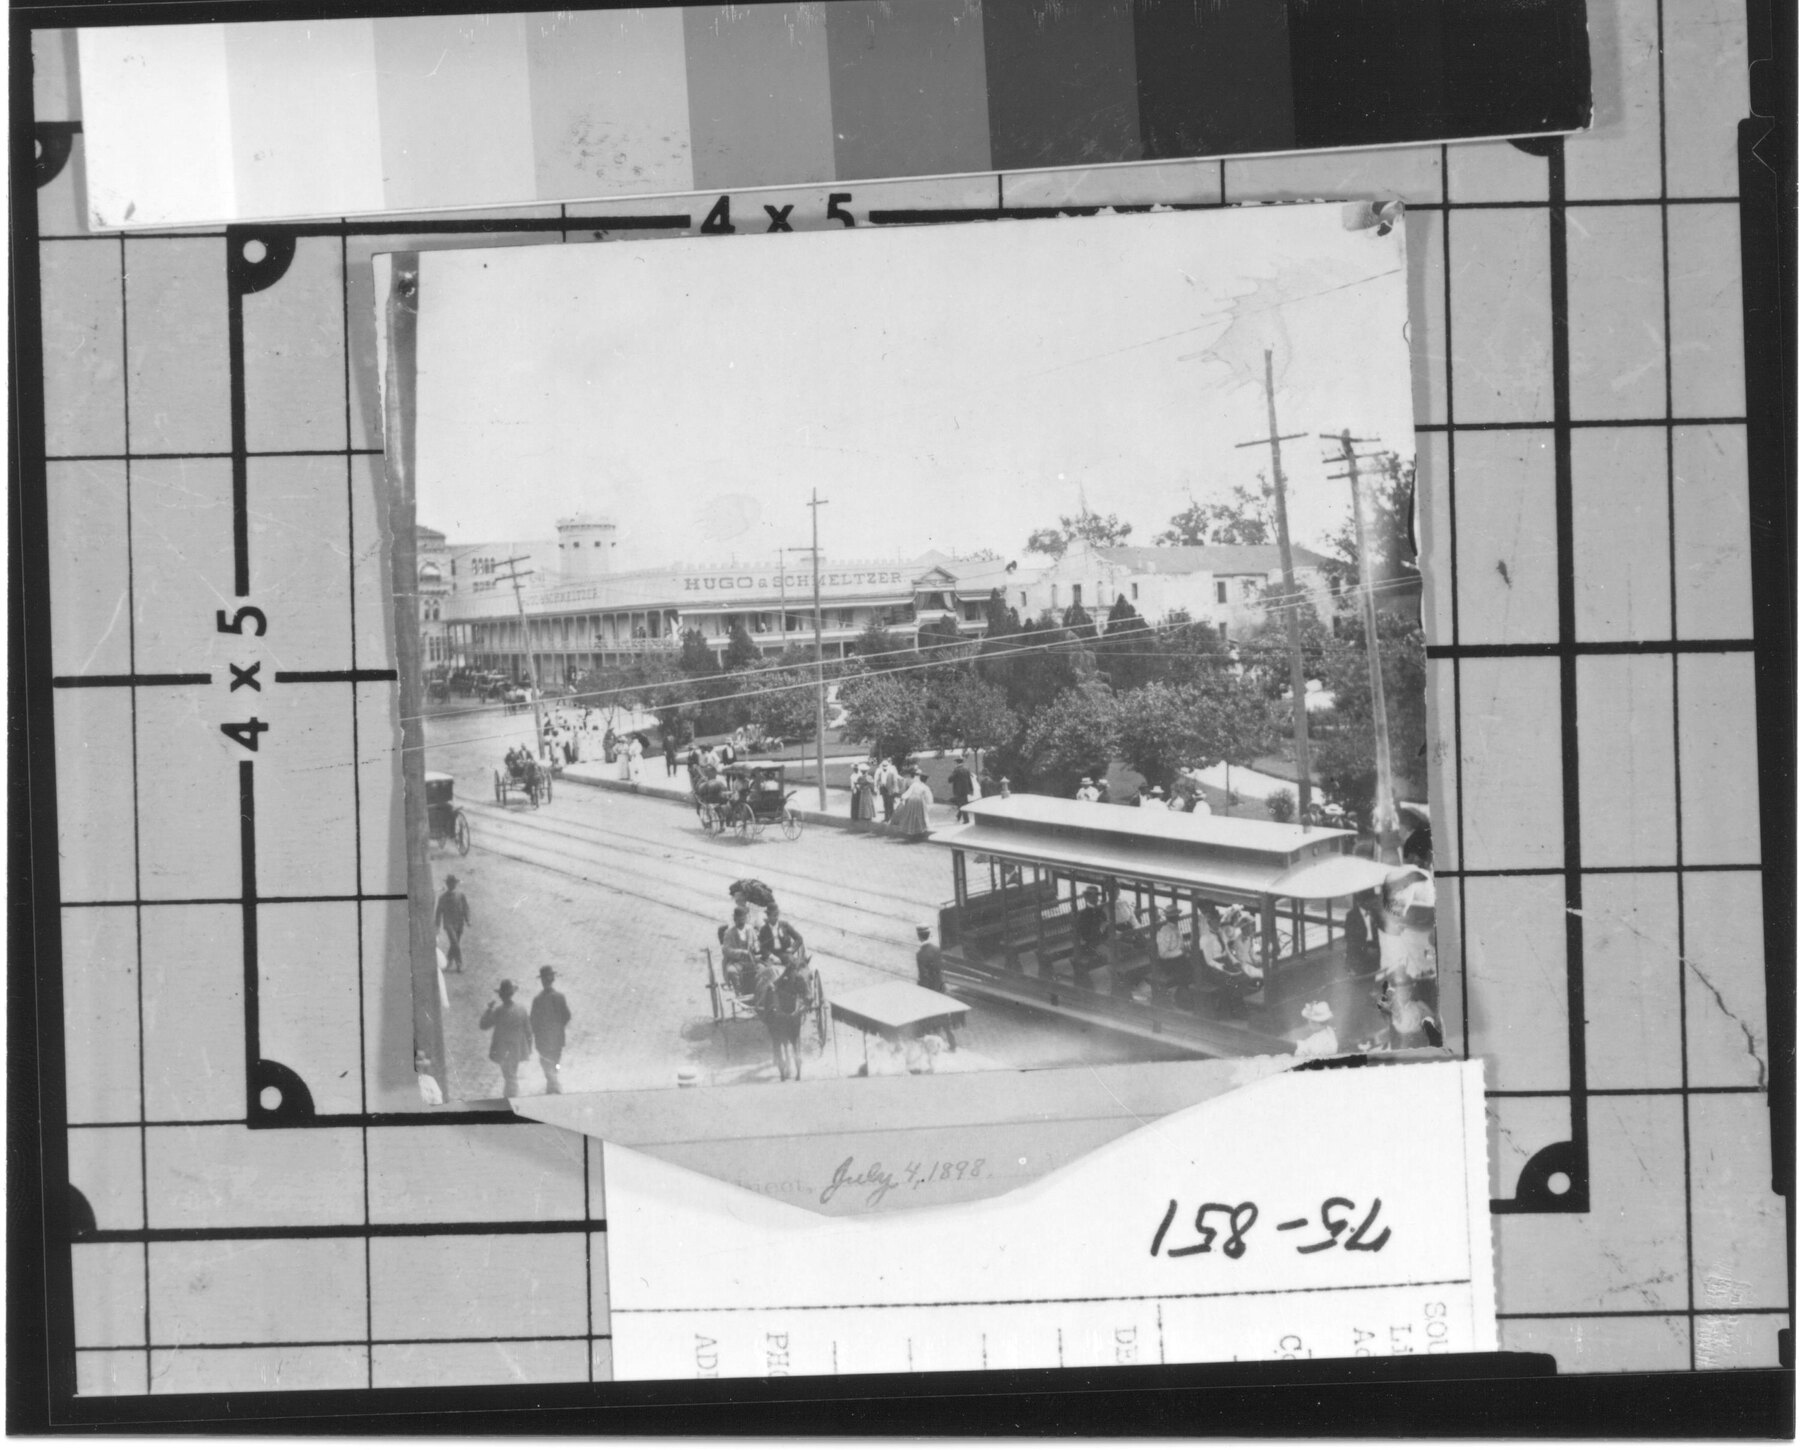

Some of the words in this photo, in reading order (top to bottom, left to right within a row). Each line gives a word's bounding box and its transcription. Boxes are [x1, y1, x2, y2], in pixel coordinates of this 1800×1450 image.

[701, 195, 736, 234] 4
[763, 204, 795, 233] x
[684, 576, 754, 591] HUGO
[758, 578, 769, 589] &
[772, 572, 903, 589] SCHMELTZER
[216, 606, 267, 637] 5
[229, 660, 261, 693] x
[220, 716, 269, 752] 4
[819, 1155, 899, 1207] July
[1150, 1197, 1392, 1259] 75-851
